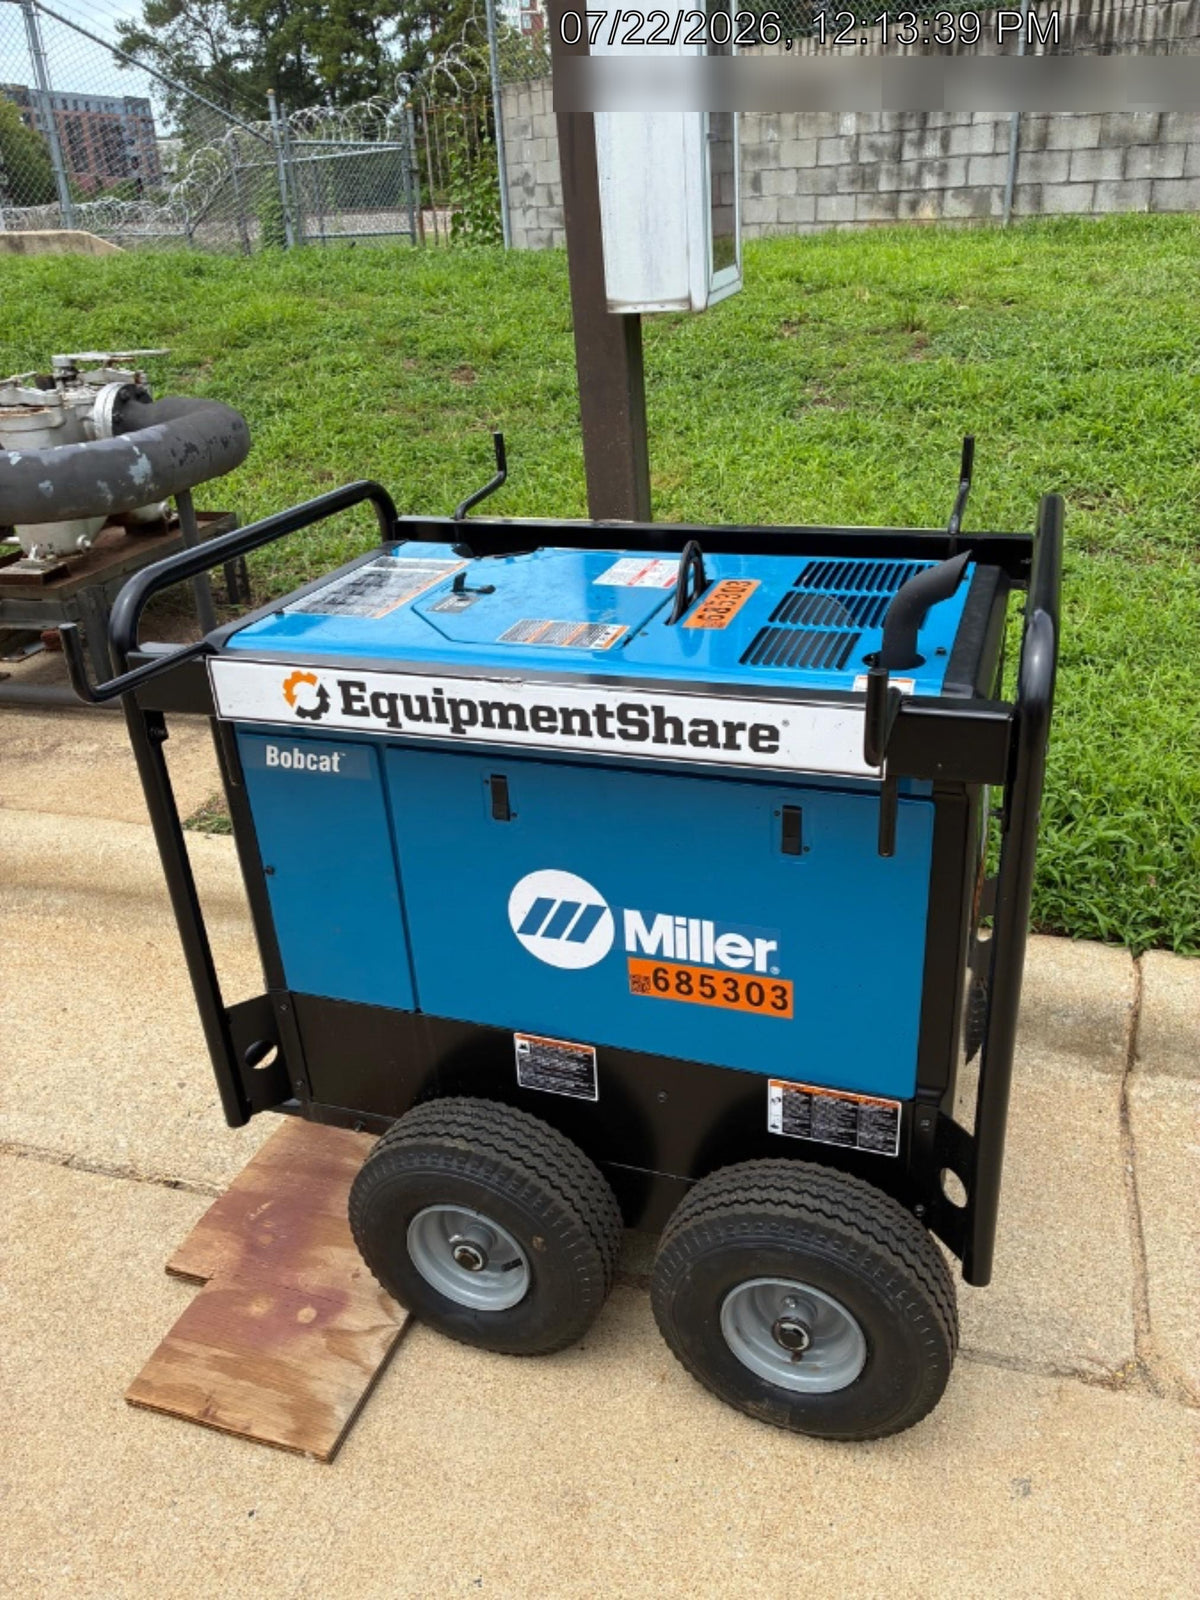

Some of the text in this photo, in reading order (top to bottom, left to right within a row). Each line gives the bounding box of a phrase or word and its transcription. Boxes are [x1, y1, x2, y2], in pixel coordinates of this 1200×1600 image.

[337, 679, 780, 754] EquipmentShare
[265, 744, 340, 773] Bobcat
[623, 908, 778, 973] Miller
[652, 967, 788, 1011] 685303
